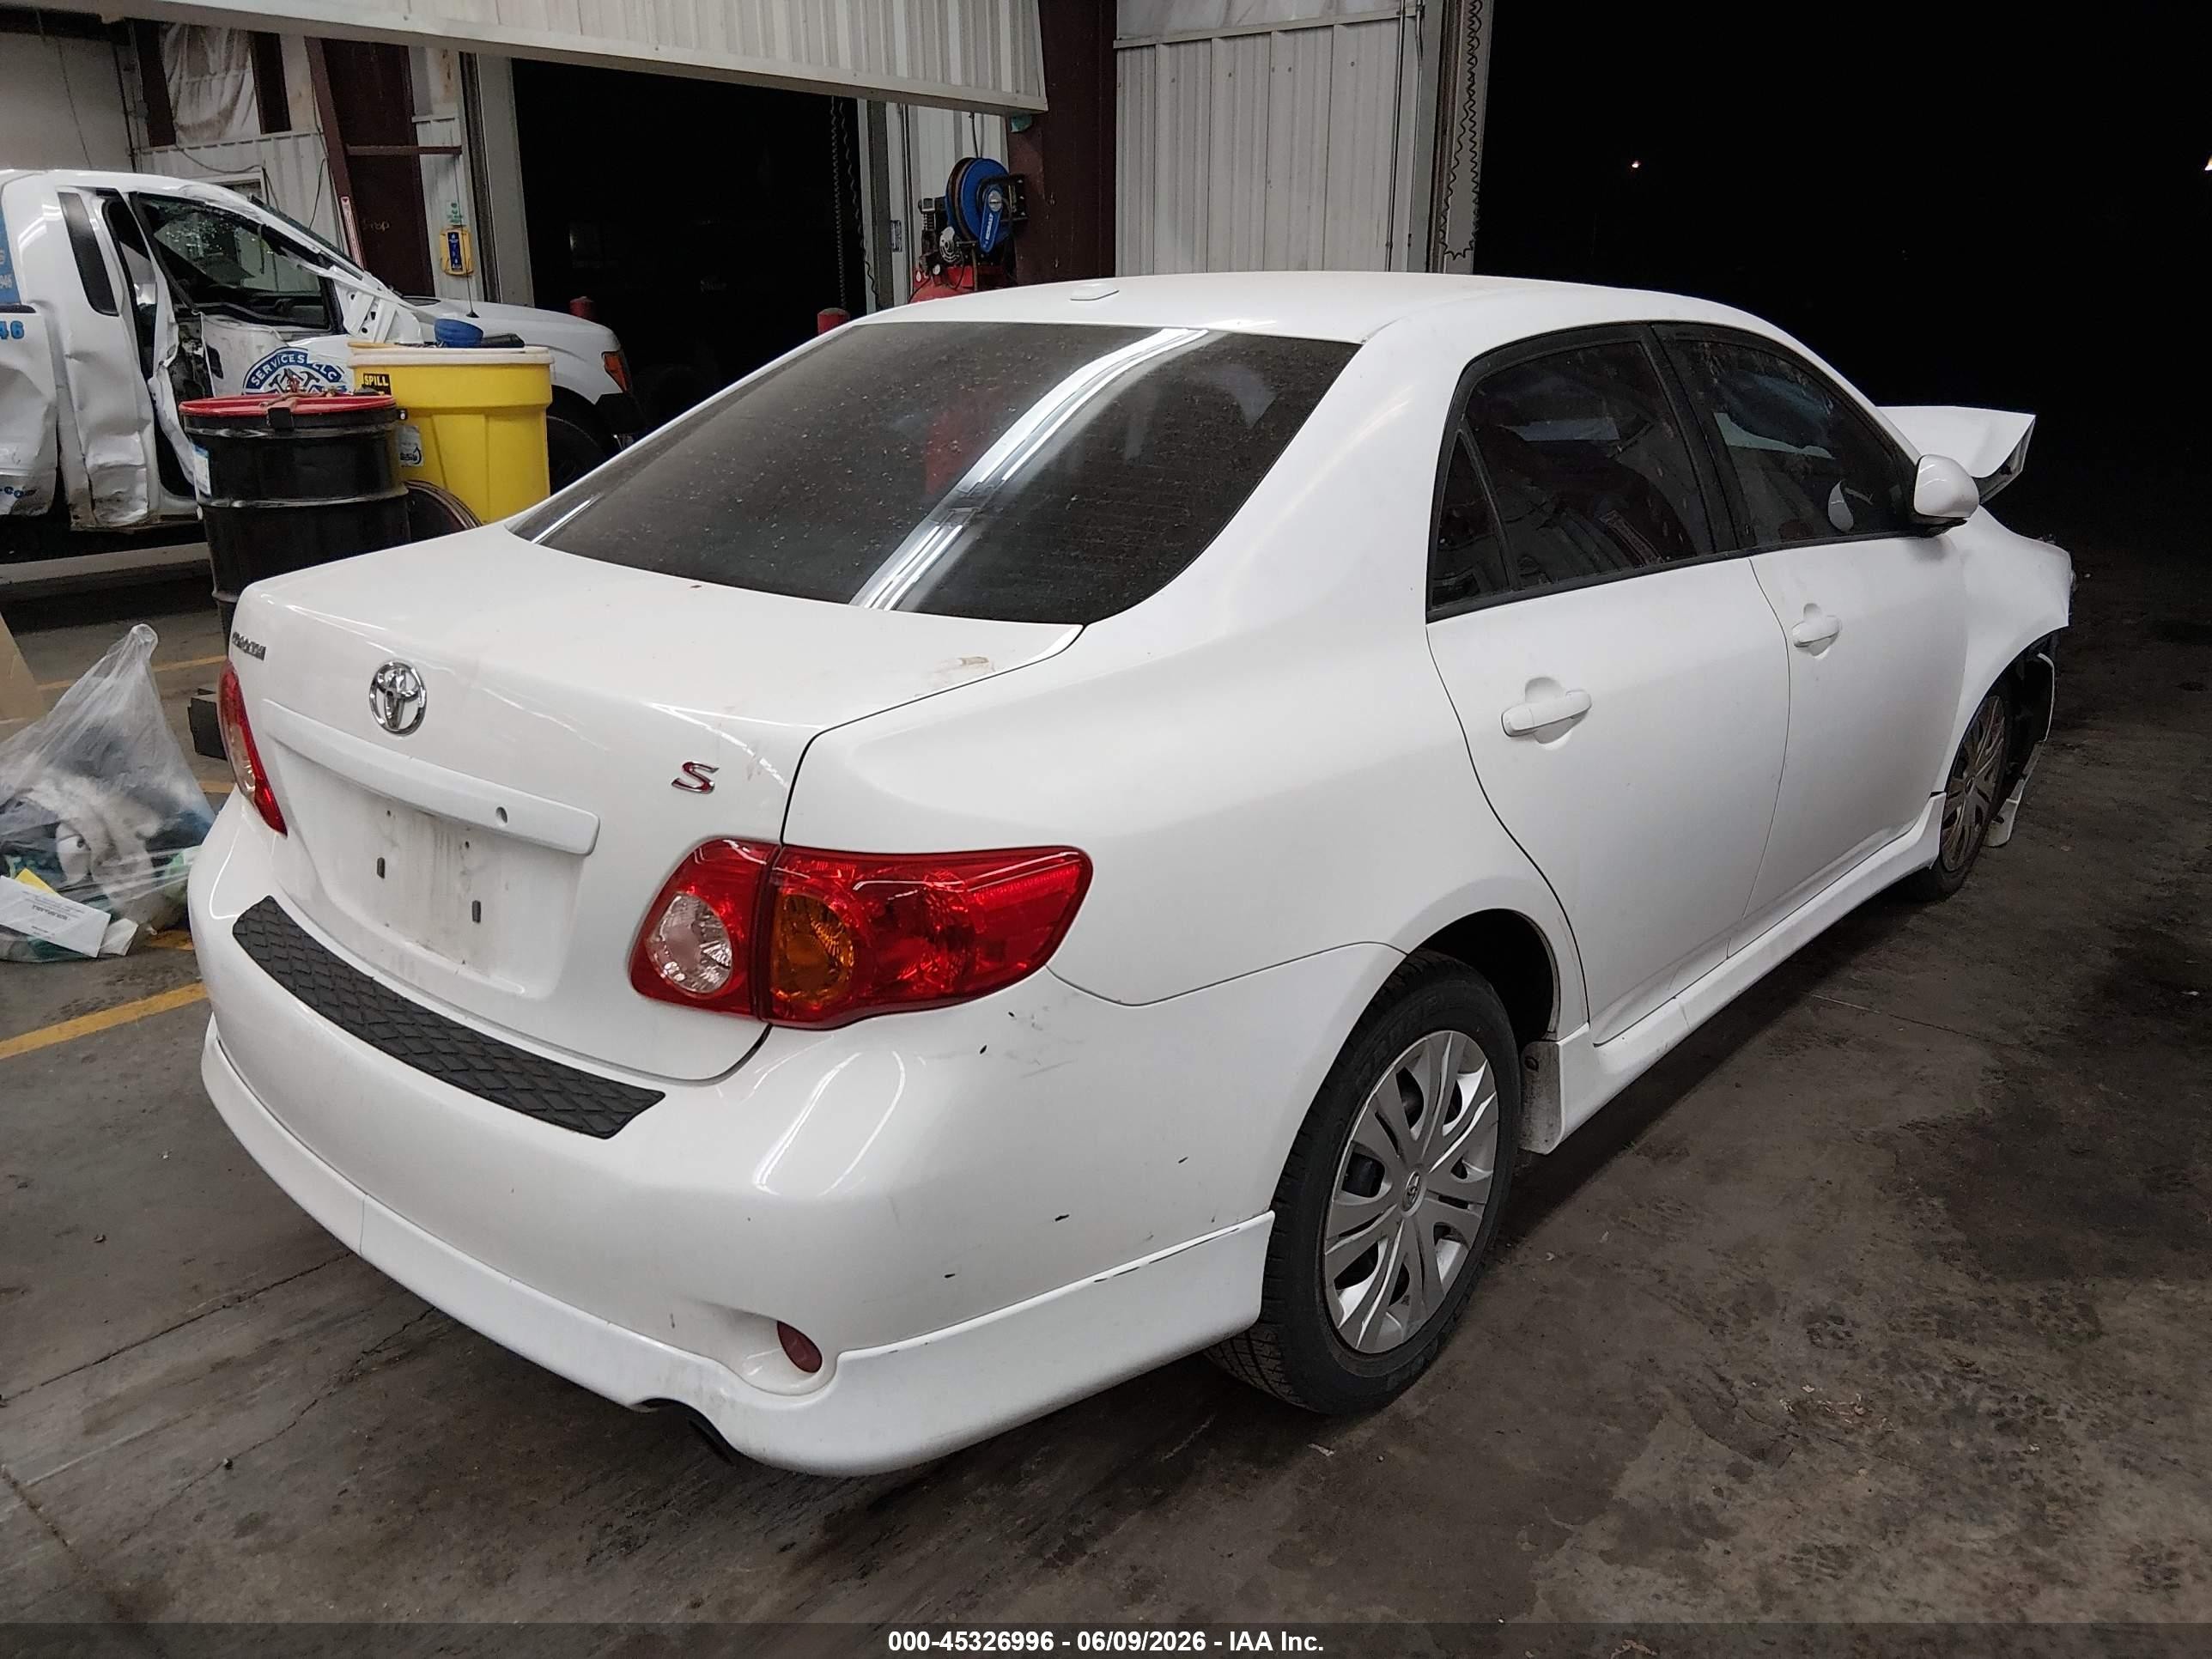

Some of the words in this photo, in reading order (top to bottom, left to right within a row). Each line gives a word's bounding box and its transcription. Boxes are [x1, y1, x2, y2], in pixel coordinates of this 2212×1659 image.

[251, 353, 306, 386] SERVICES
[364, 375, 389, 386] SPILL
[672, 761, 720, 794] S
